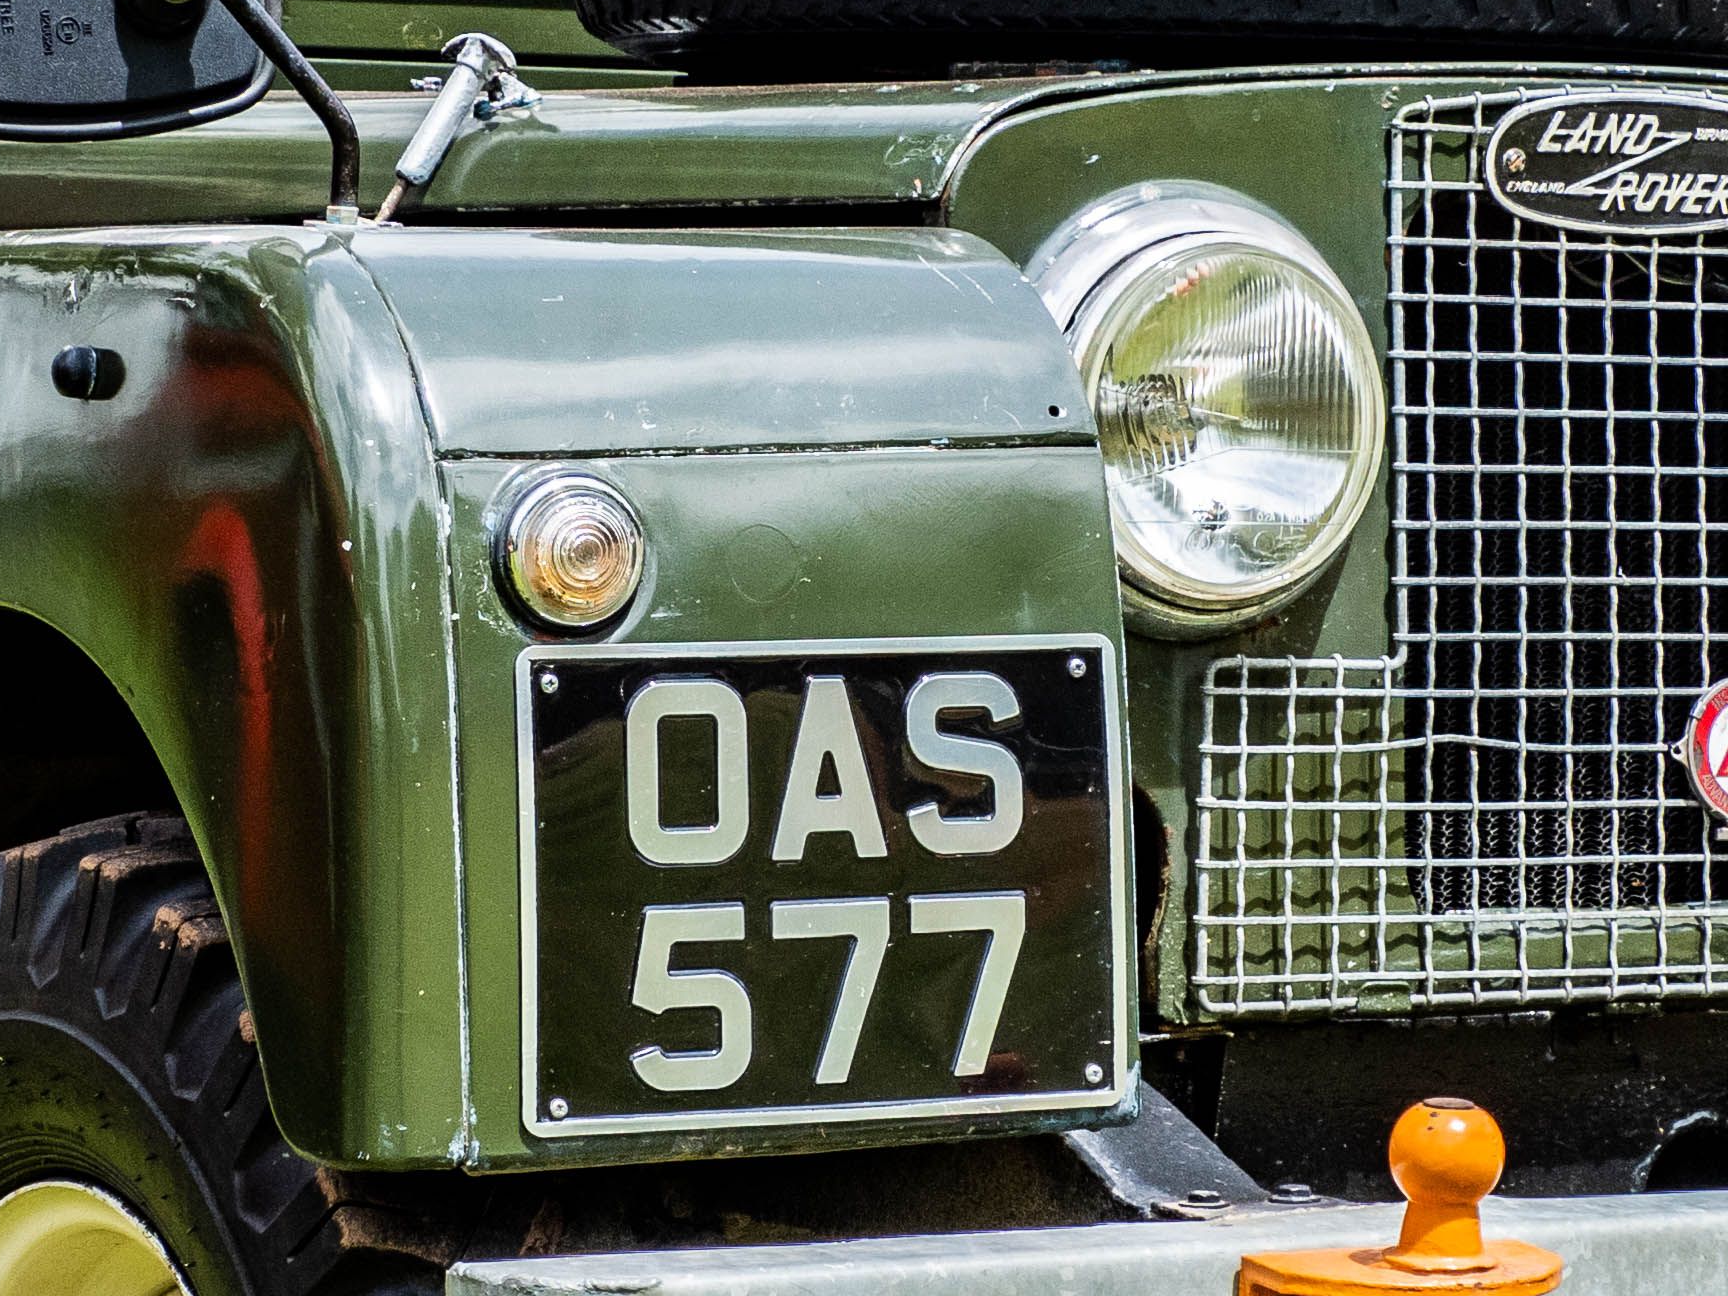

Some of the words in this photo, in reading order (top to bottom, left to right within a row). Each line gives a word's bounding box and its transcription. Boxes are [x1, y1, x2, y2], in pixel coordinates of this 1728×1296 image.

[1536, 111, 1659, 155] LAND
[626, 671, 1024, 867] OAS
[630, 891, 1026, 1091] 577
